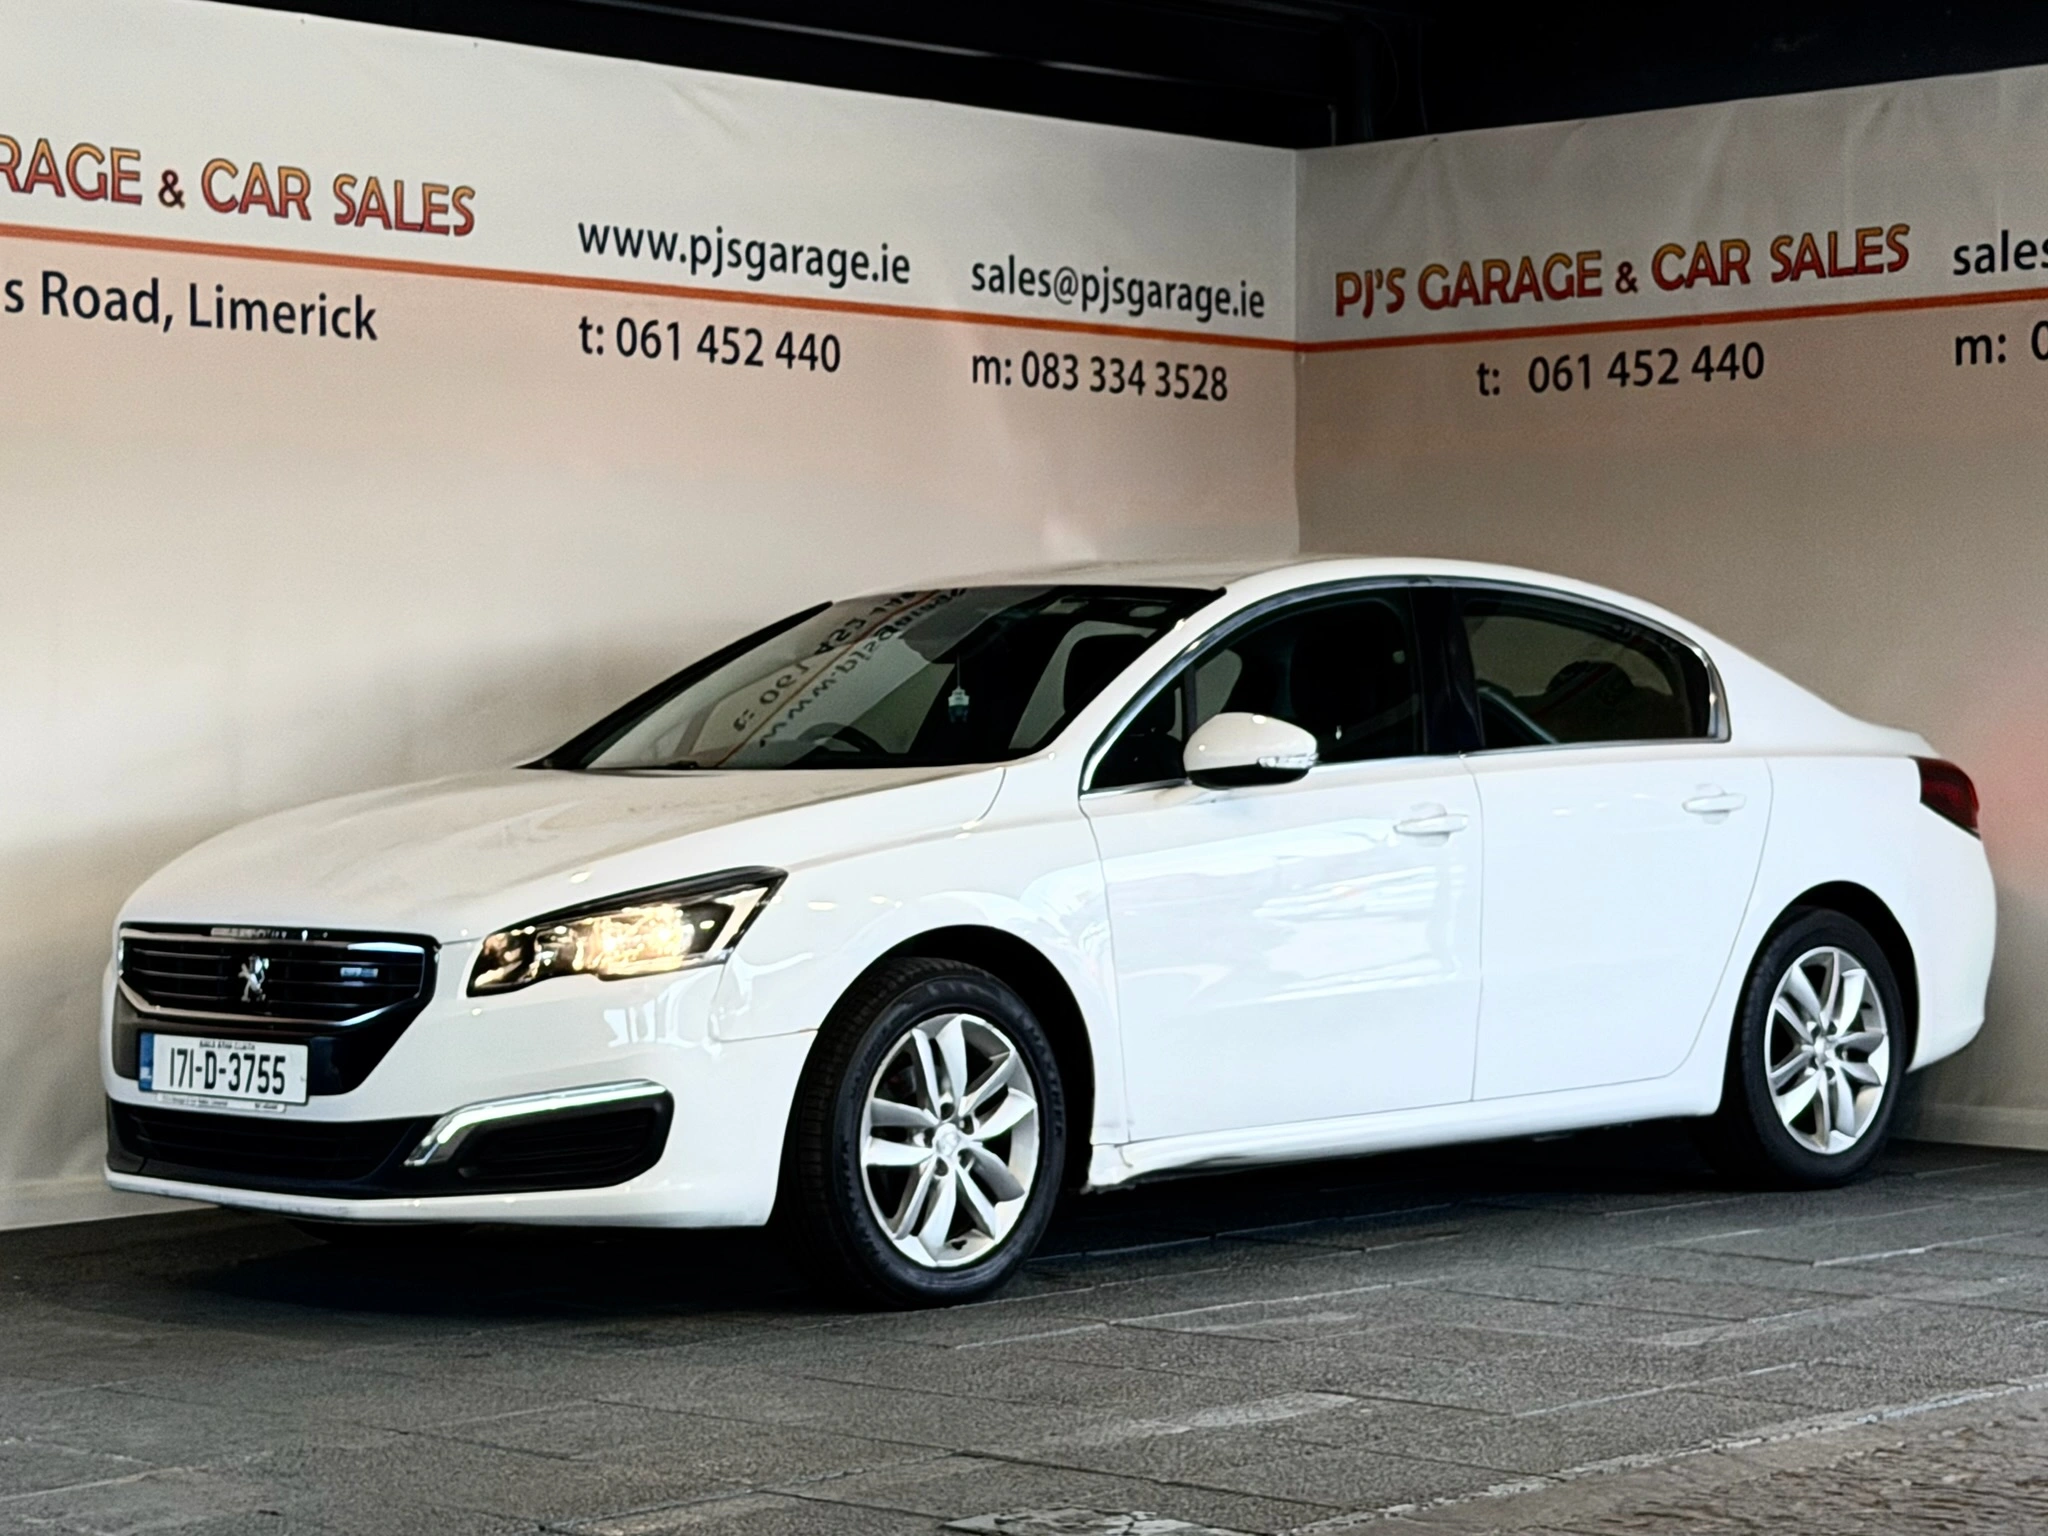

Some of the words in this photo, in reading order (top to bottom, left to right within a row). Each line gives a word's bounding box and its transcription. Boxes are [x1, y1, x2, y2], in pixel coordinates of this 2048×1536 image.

[159, 170, 185, 208] &
[201, 159, 312, 221] CAR
[333, 174, 476, 237] SALES
[578, 222, 910, 285] www.pjsgarage.ie
[1418, 251, 1602, 310] GARAGE
[1616, 262, 1638, 294] &
[1652, 240, 1750, 291] CAR
[1770, 224, 1910, 283] SALES
[42, 270, 173, 333] Road,
[190, 283, 378, 341] Limerick
[971, 255, 1265, 321] sales@pjsgarage.ie
[578, 316, 604, 355] t:
[616, 318, 679, 361] 061
[697, 325, 764, 367] 452
[775, 331, 840, 373] 440
[1477, 363, 1501, 396] t:
[1529, 354, 1590, 394] 061
[1608, 348, 1679, 388] 452
[1692, 342, 1764, 383] 440
[1955, 334, 2006, 366] m:
[973, 355, 1012, 386] m:
[1022, 350, 1078, 391] 083
[1090, 356, 1146, 396] 334
[1155, 361, 1227, 402] 3528
[170, 1048, 286, 1095] 171-D-3755
